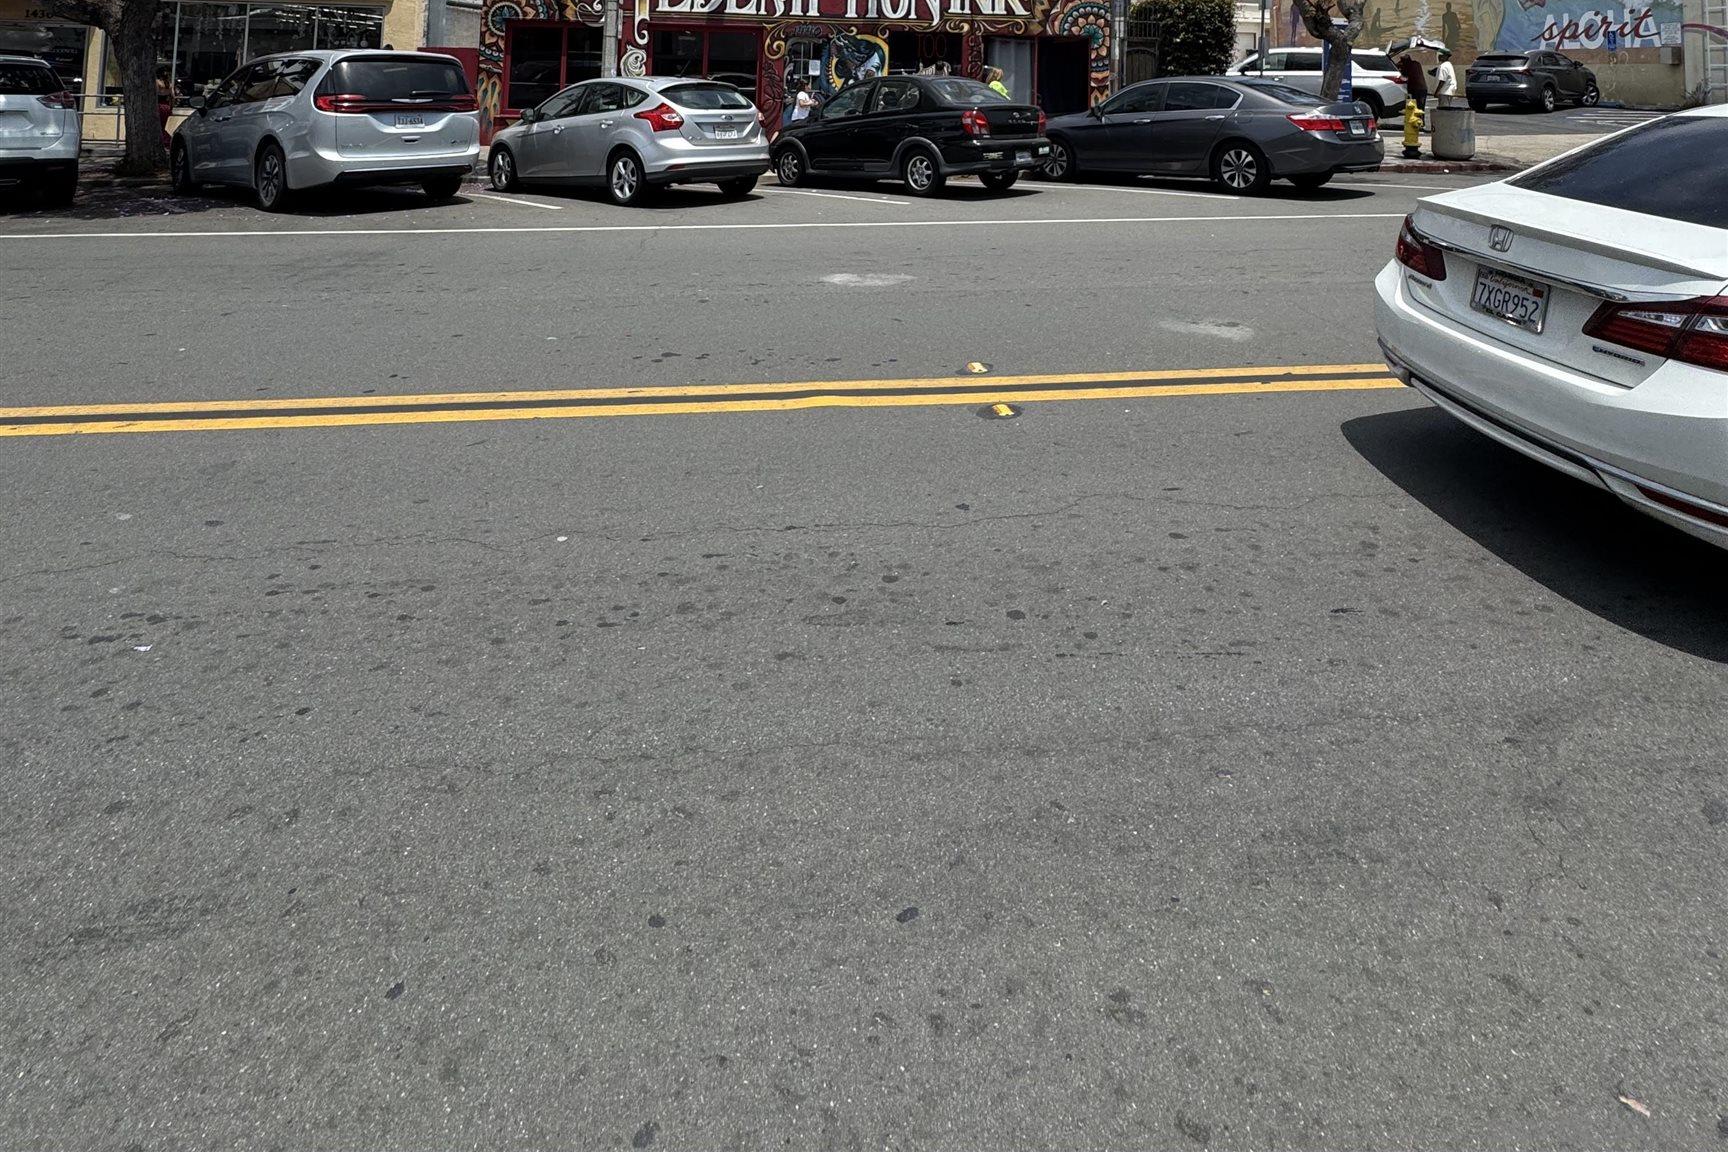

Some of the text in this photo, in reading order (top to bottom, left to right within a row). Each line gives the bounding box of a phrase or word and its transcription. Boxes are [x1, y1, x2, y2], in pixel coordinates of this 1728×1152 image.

[1531, 8, 1661, 51] spirit
[1540, 7, 1662, 50] ALOHA
[1479, 282, 1540, 324] 7XGR952
